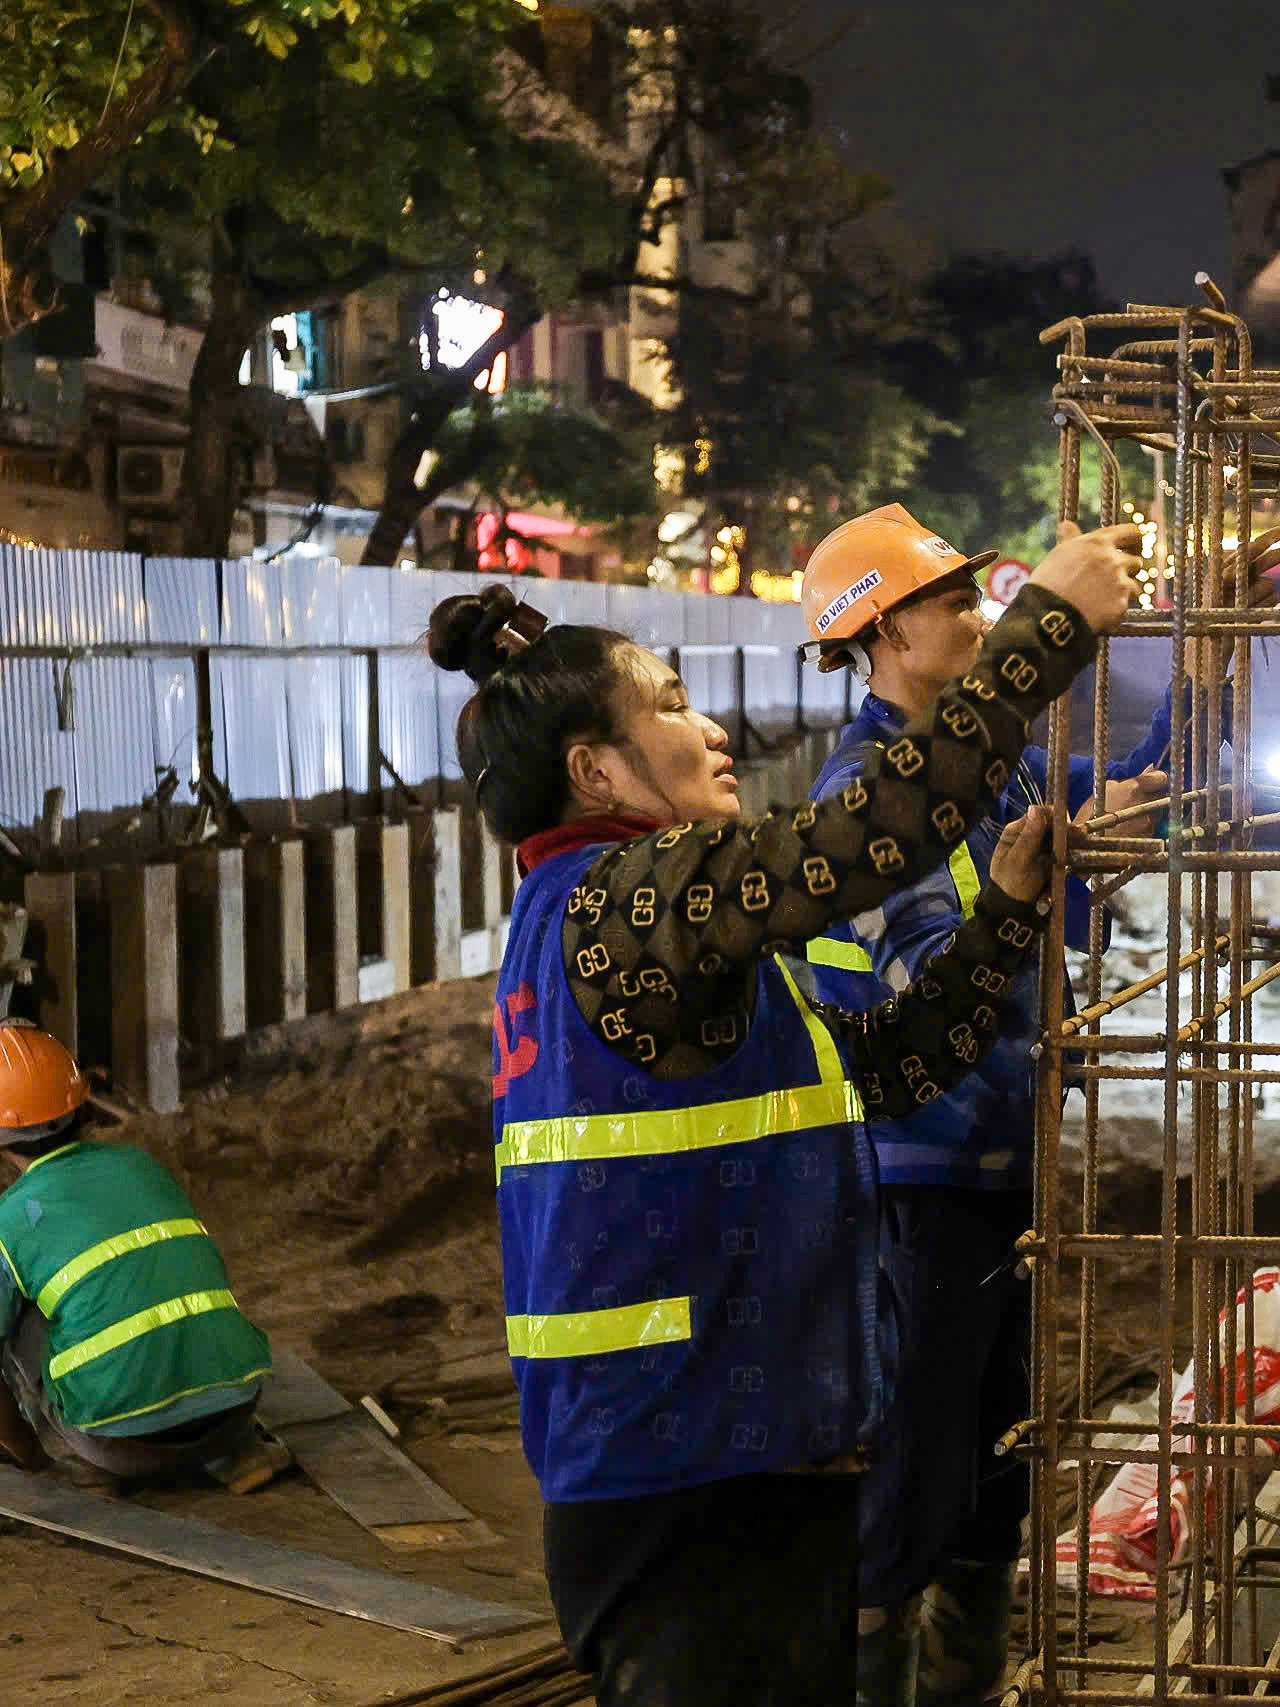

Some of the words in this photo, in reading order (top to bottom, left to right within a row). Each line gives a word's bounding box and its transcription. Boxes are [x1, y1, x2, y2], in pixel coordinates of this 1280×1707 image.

[818, 614, 831, 632] XD
[829, 595, 850, 617] VIET
[851, 572, 879, 599] PHAT
